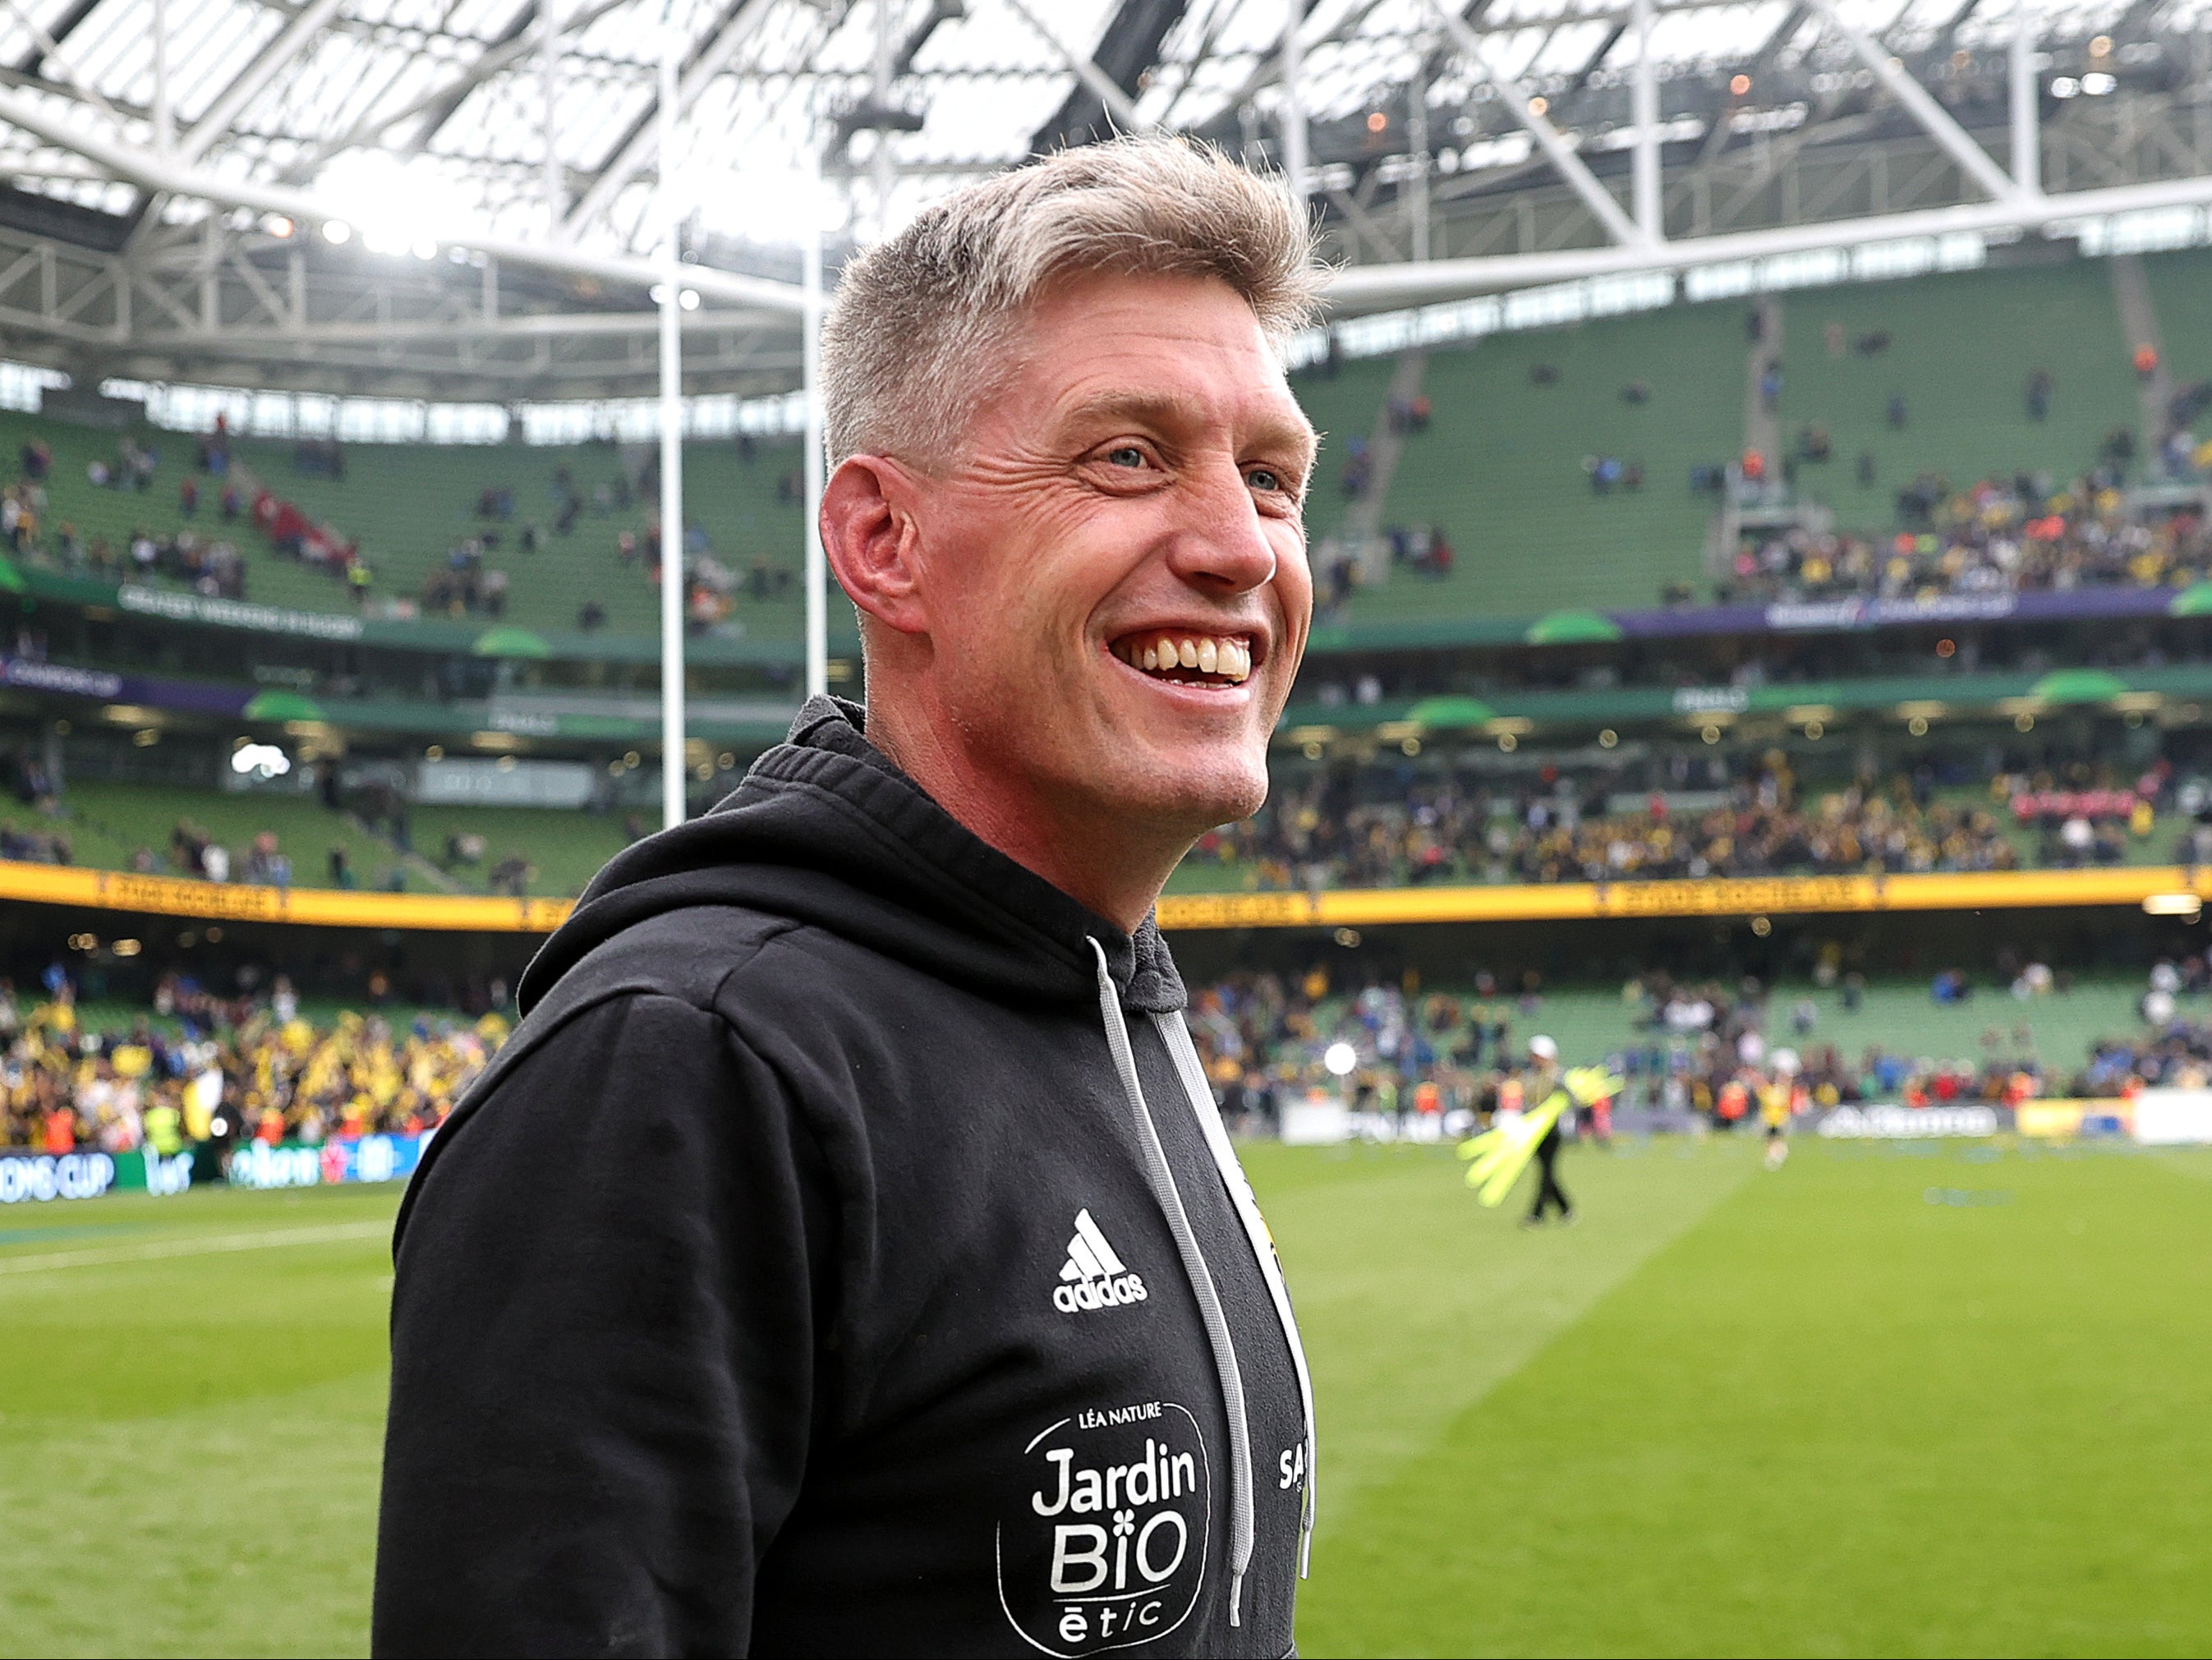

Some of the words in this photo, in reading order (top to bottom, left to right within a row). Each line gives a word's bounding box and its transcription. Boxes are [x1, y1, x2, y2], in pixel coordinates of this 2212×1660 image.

[56, 1153, 115, 1199] CUP
[1053, 1273, 1148, 1313] adidas
[1078, 1408, 1107, 1429] LÉA
[1109, 1401, 1162, 1425] NATURE
[1032, 1438, 1196, 1516] Jardin
